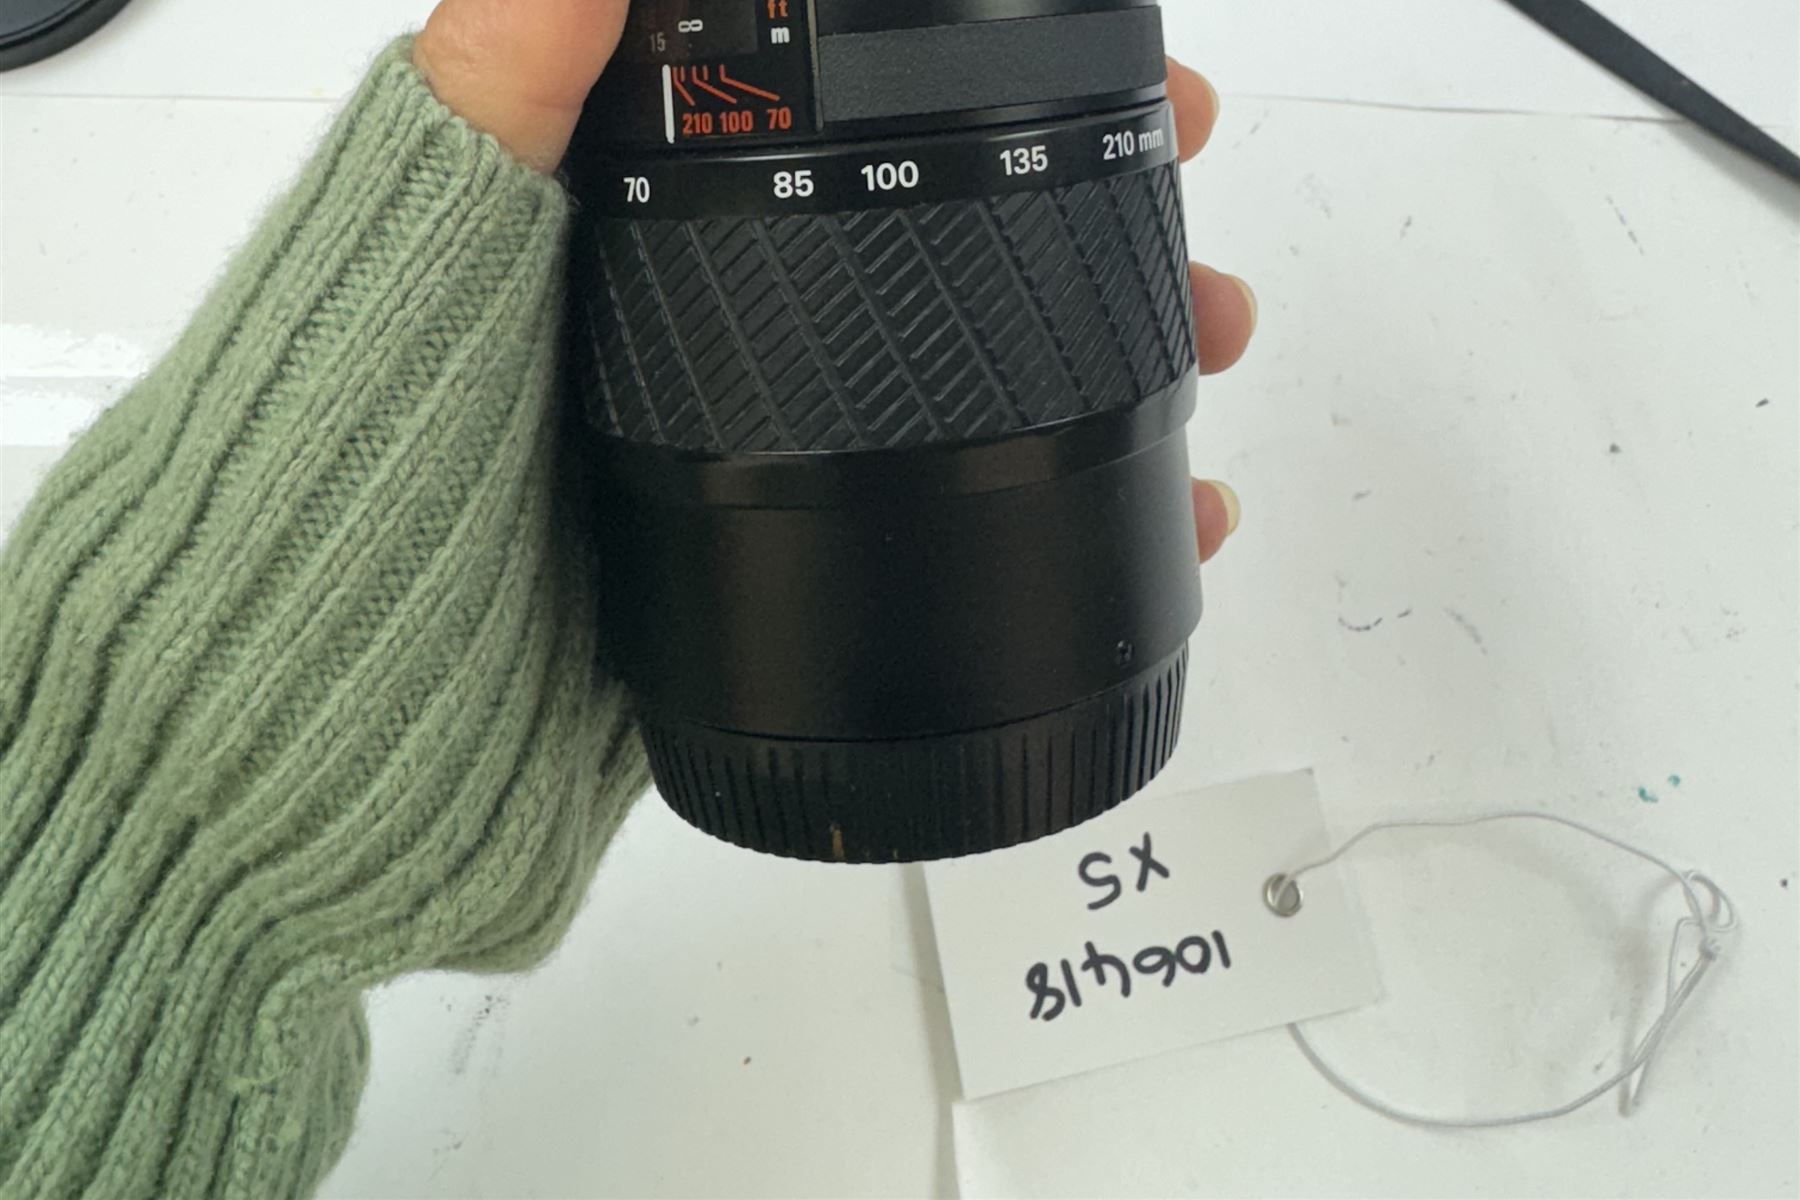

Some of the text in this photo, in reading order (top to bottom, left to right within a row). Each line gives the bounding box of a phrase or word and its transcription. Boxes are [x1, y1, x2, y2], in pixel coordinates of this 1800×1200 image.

[770, 26, 791, 44] m
[682, 106, 792, 136] 210 100 70
[623, 126, 1165, 204] 70 85 100 135 210 mm
[1025, 929, 1232, 1022] 106418
